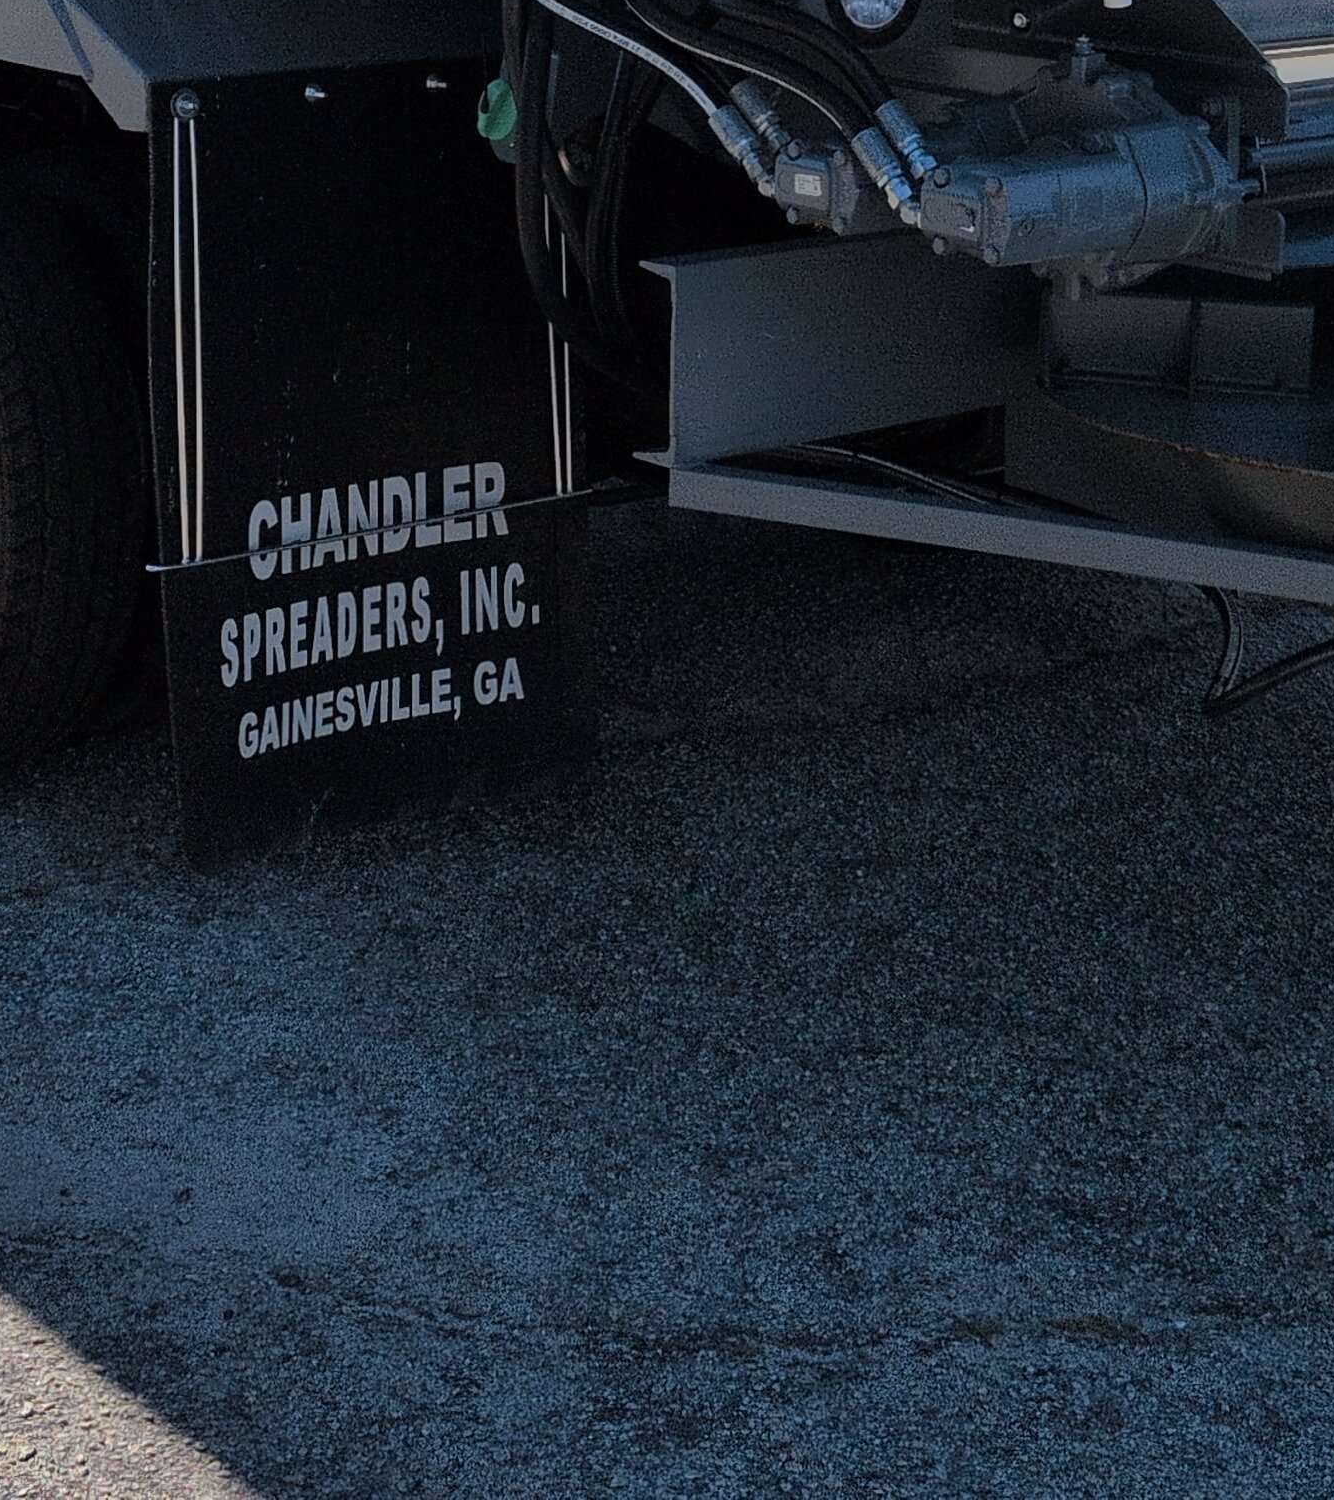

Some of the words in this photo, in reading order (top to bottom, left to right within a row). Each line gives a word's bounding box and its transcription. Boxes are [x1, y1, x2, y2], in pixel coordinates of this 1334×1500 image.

[247, 461, 509, 581] CHANDLER
[220, 576, 444, 688] SPREADERS,
[460, 562, 540, 636] INC.
[238, 667, 461, 760] GAINESVILLE,
[473, 657, 525, 706] GA
